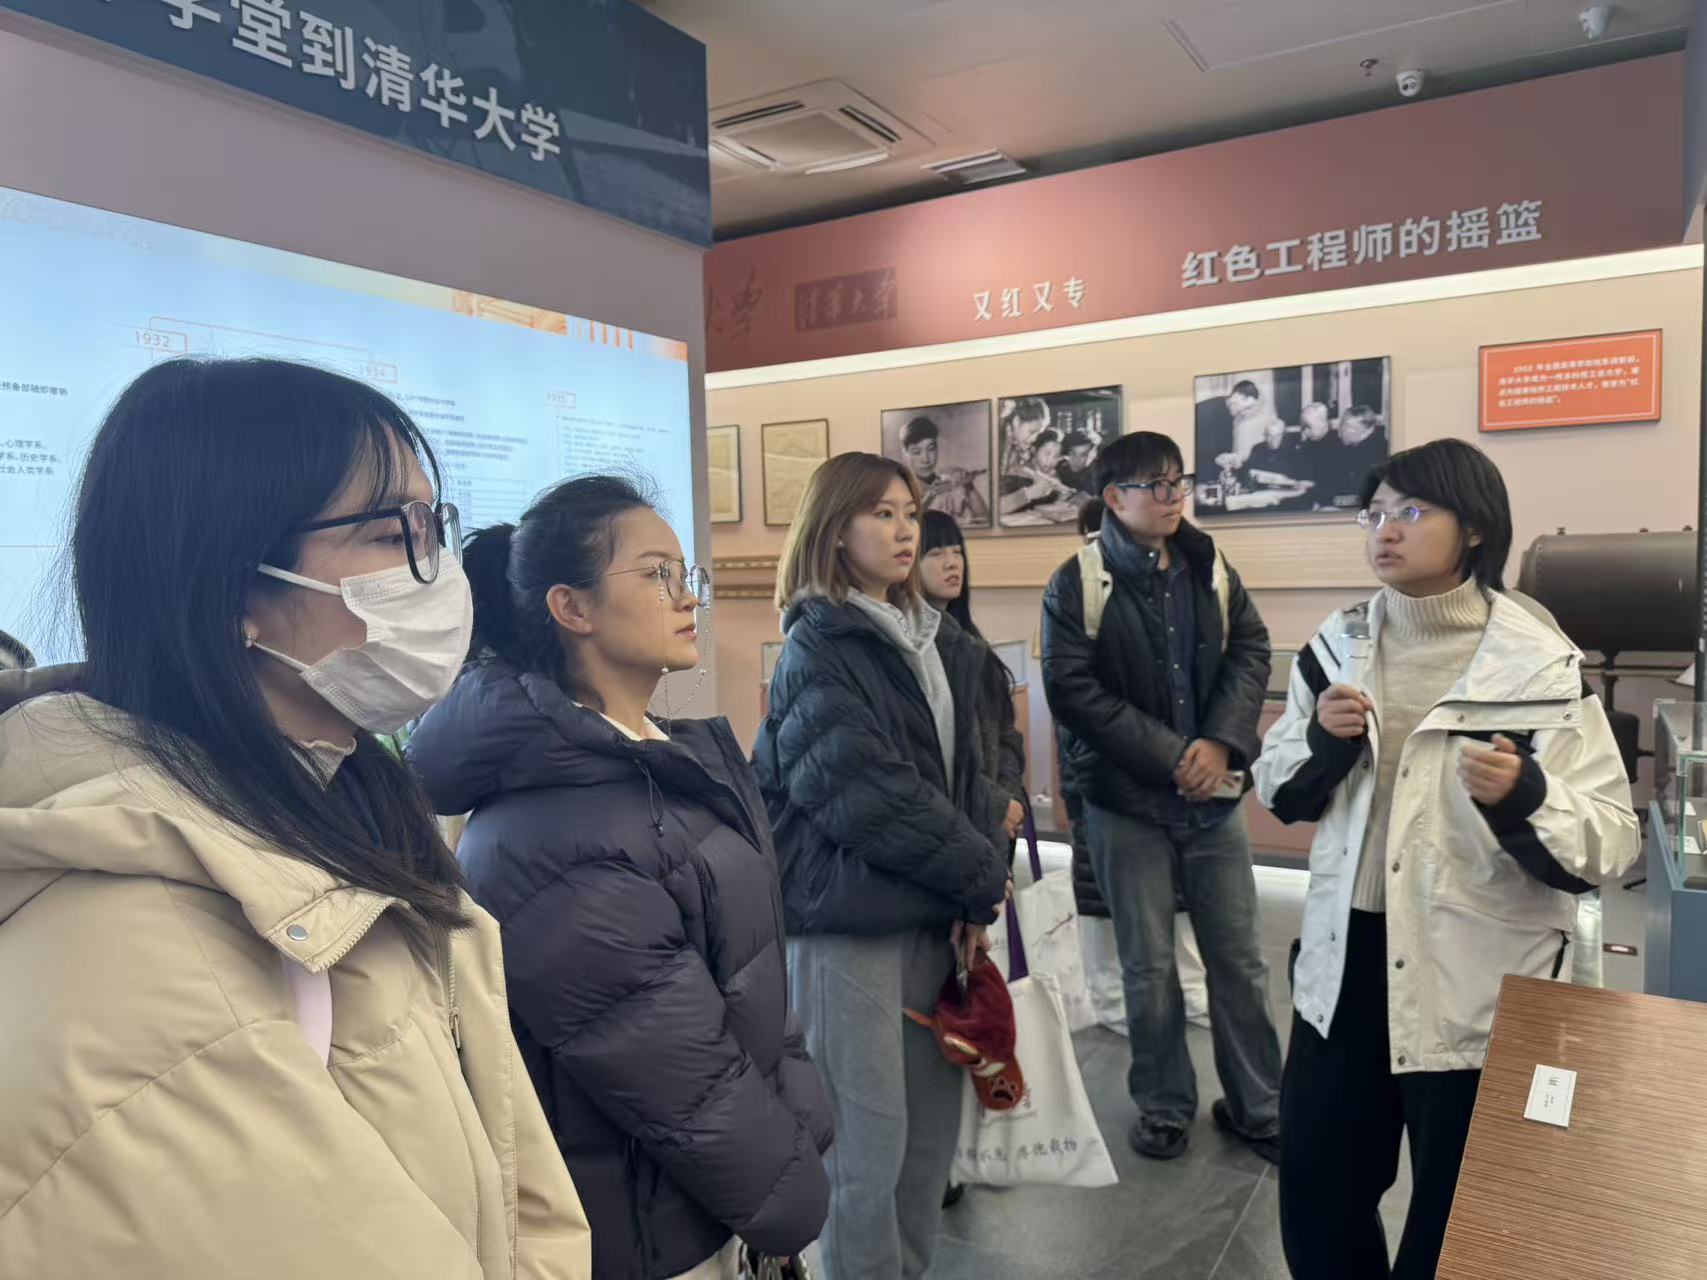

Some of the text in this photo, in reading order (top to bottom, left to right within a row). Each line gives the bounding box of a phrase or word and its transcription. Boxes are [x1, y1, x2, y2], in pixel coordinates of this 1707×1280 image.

[1181, 199, 1543, 288] 红色工程师的摇篮
[973, 275, 1087, 322] 又红又专
[136, 331, 170, 348] 1932
